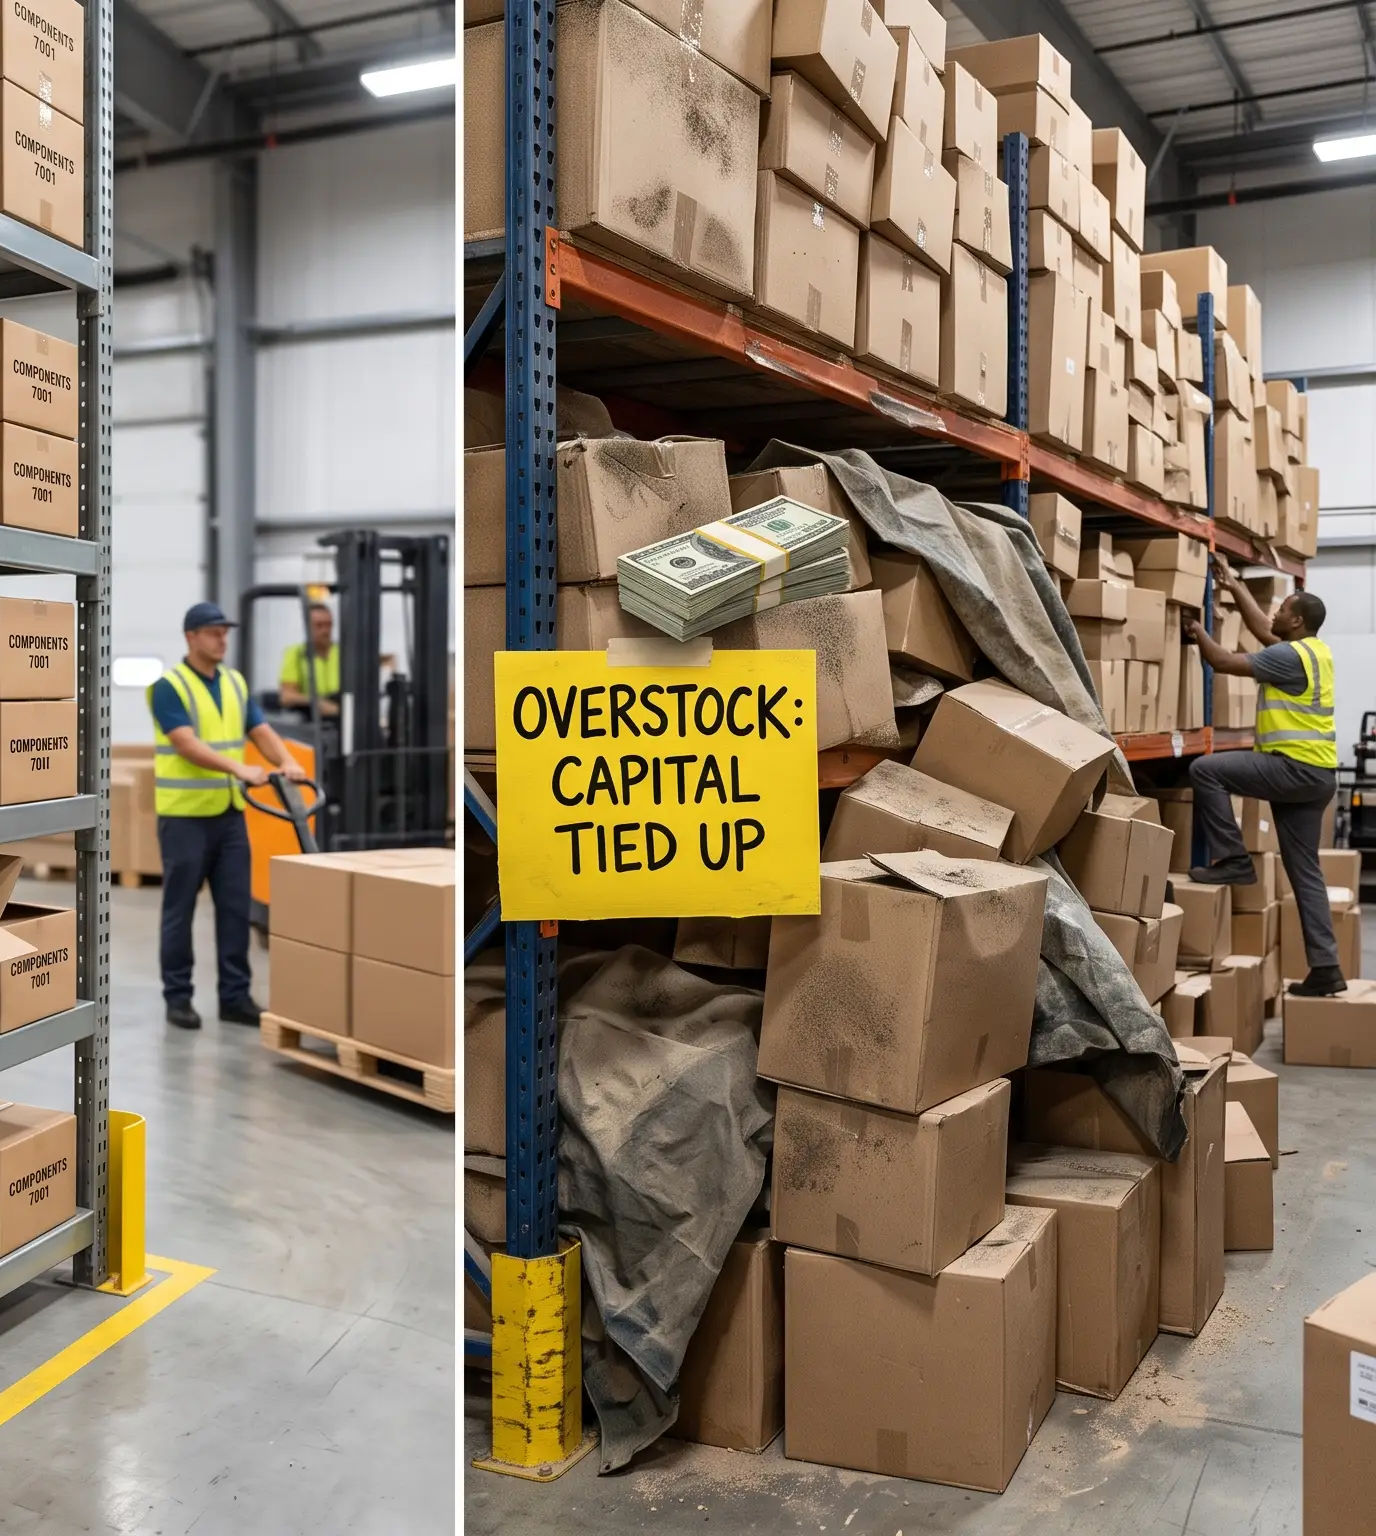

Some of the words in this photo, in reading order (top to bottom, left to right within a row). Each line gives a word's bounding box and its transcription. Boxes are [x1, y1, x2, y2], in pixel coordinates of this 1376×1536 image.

[14, 2, 74, 52] COMPONENTS
[33, 35, 55, 61] 7001
[15, 130, 75, 175] COMPONENTS
[34, 161, 56, 186] 7001
[13, 359, 71, 391] COMPONENTS
[31, 385, 52, 404] 7001
[31, 486, 52, 504] 7001
[8, 634, 69, 651] COMPONENTS
[28, 654, 49, 669] 7001
[513, 684, 803, 740] OVERSTOCK:
[552, 756, 761, 806] CAPITAL
[554, 822, 677, 875] TIED
[700, 819, 765, 872] UP
[30, 971, 50, 989] 7001
[9, 1157, 67, 1197] COMPONENTS
[28, 1185, 49, 1206] 7001
